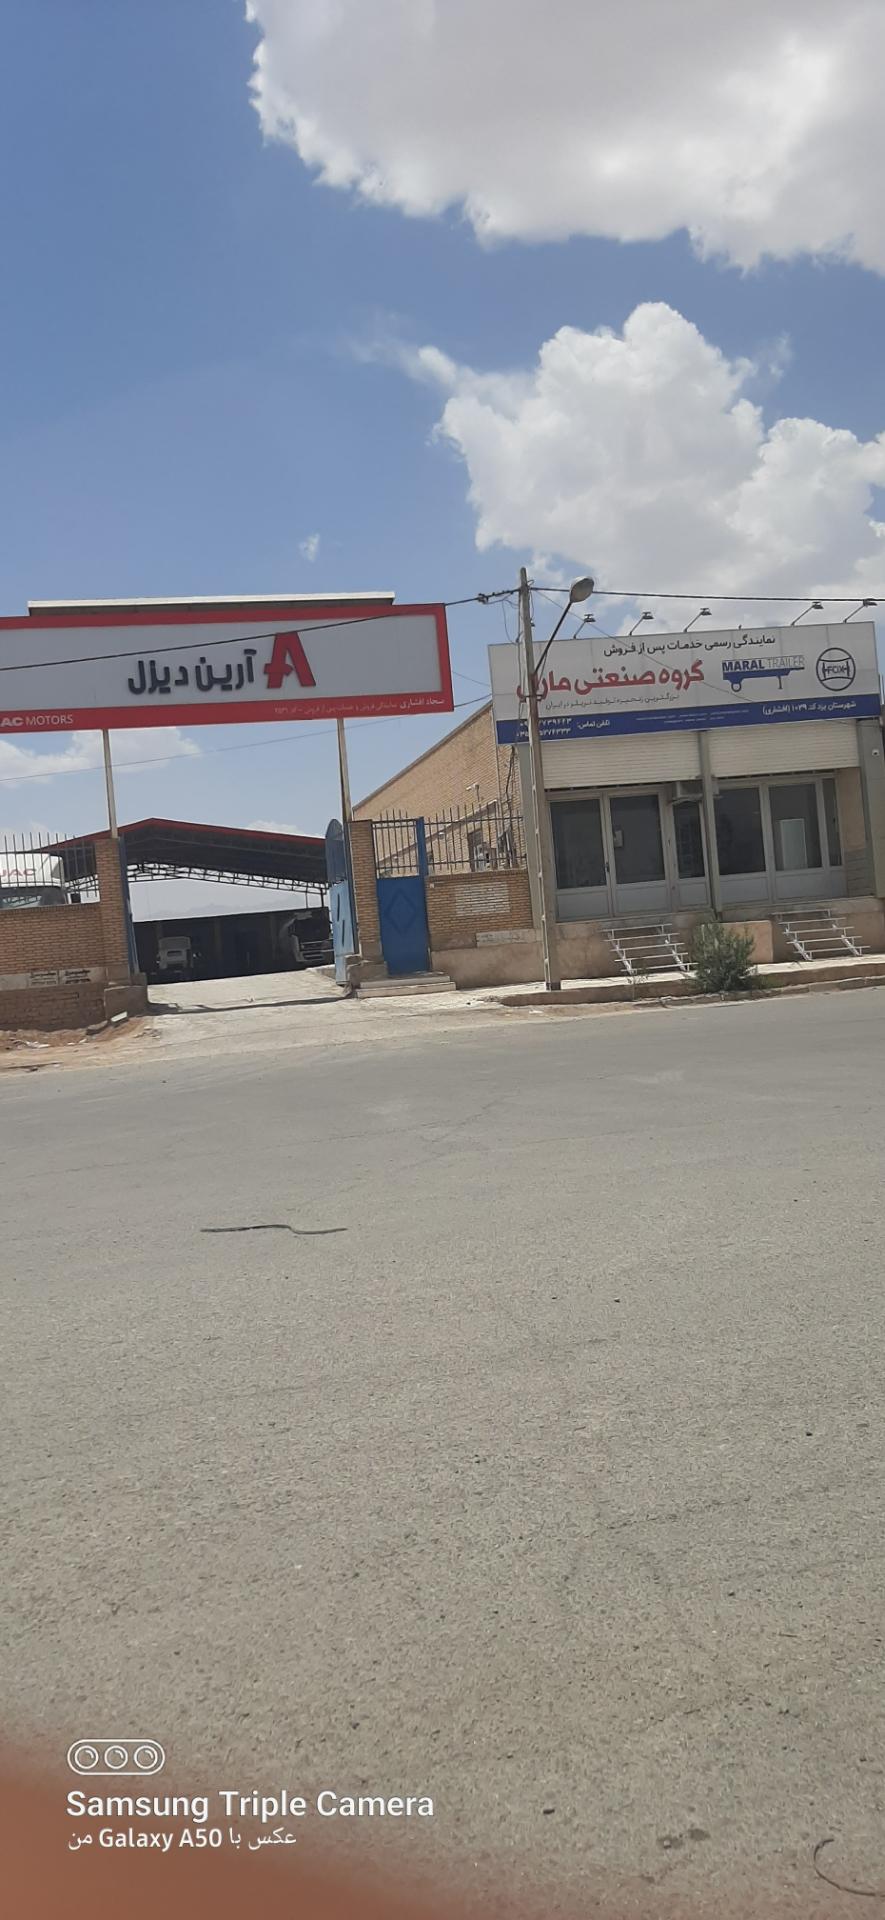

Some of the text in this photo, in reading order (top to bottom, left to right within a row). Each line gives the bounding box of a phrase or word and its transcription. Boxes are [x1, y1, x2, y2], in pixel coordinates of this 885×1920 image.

[603, 634, 776, 657] نمایندگی رسمی خدمات پس از فروش
[127, 648, 257, 695] آرین دیزل
[658, 659, 705, 691] گروه
[722, 655, 805, 672] MARAL TRAILER
[574, 666, 656, 695] صنعتی
[0, 714, 74, 727] AC MOTORS
